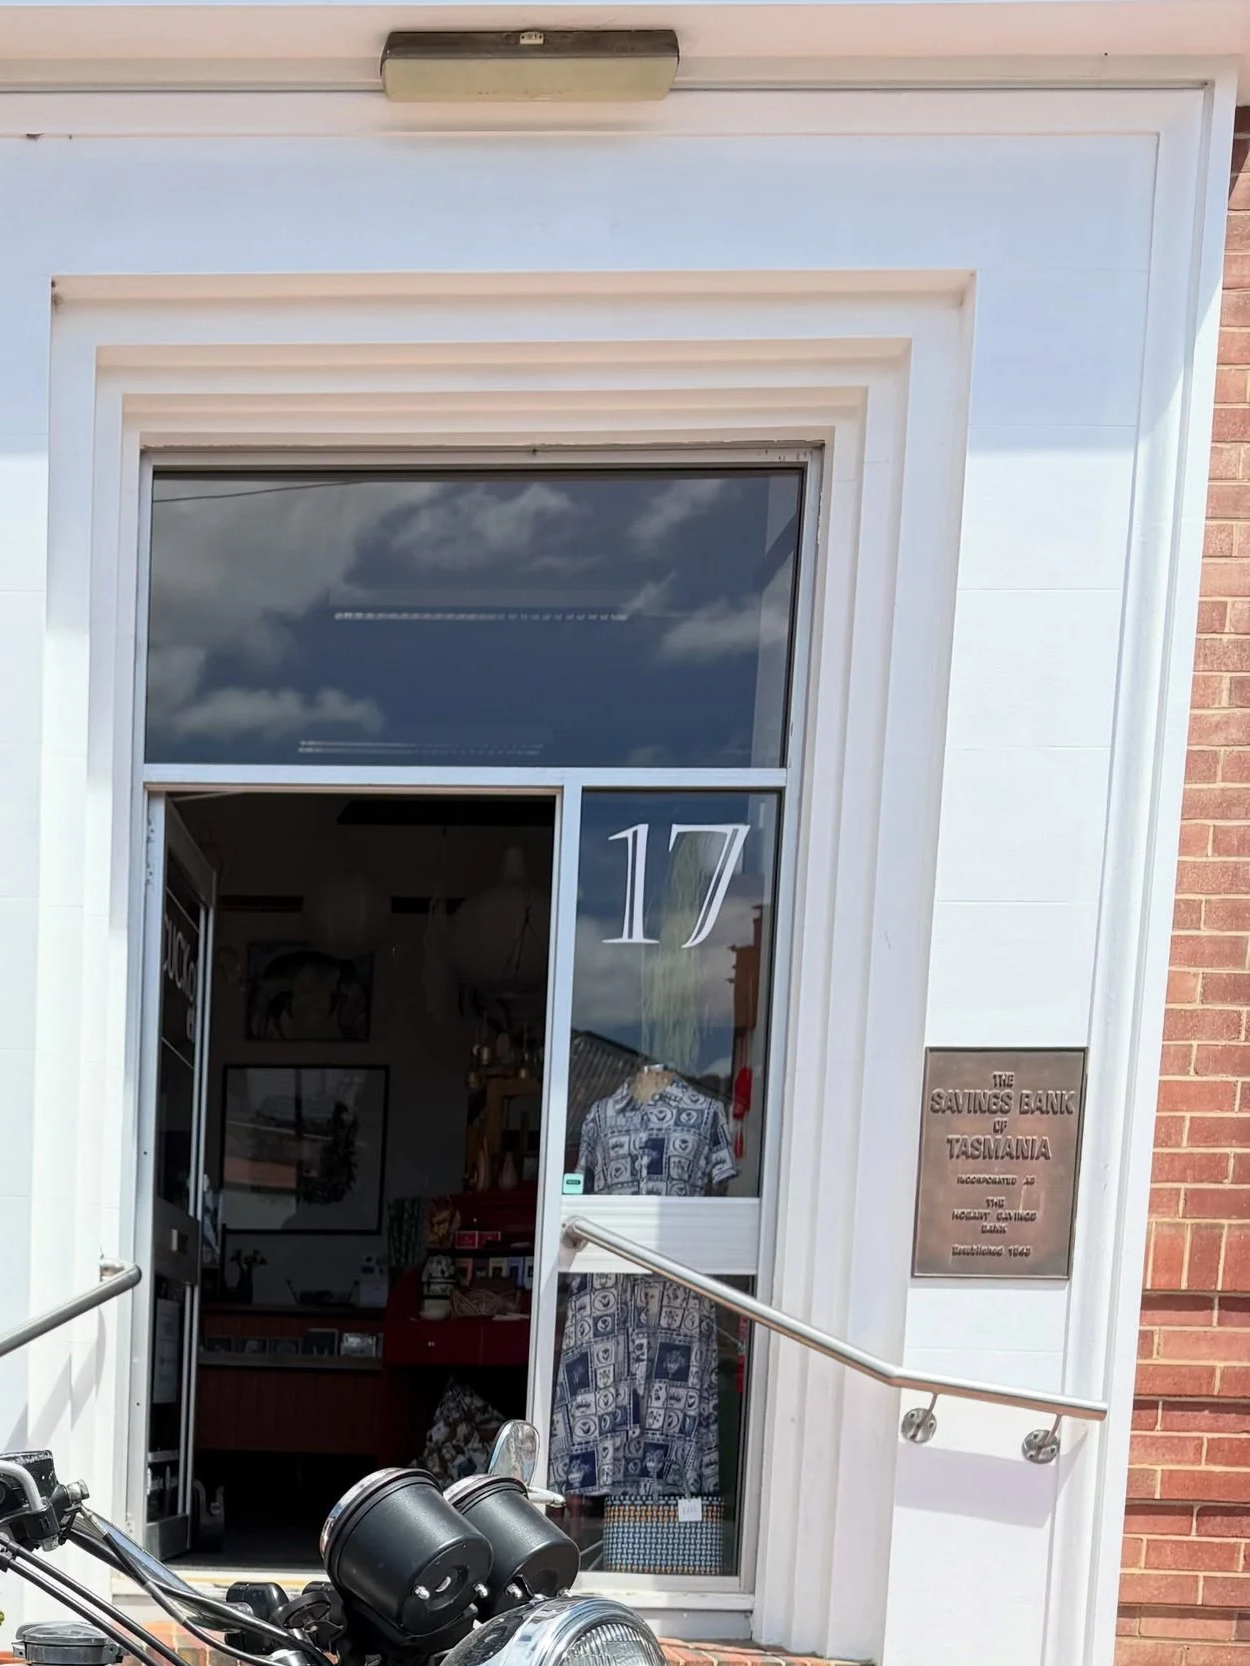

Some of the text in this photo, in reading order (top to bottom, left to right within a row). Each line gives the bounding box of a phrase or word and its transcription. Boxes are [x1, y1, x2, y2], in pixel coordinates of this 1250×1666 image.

[603, 823, 750, 948] 17
[993, 1072, 1015, 1087] THE
[930, 1089, 1076, 1115] SAVINGS BANK
[993, 1118, 1008, 1133] OF
[947, 1135, 1052, 1160] TASMANIA
